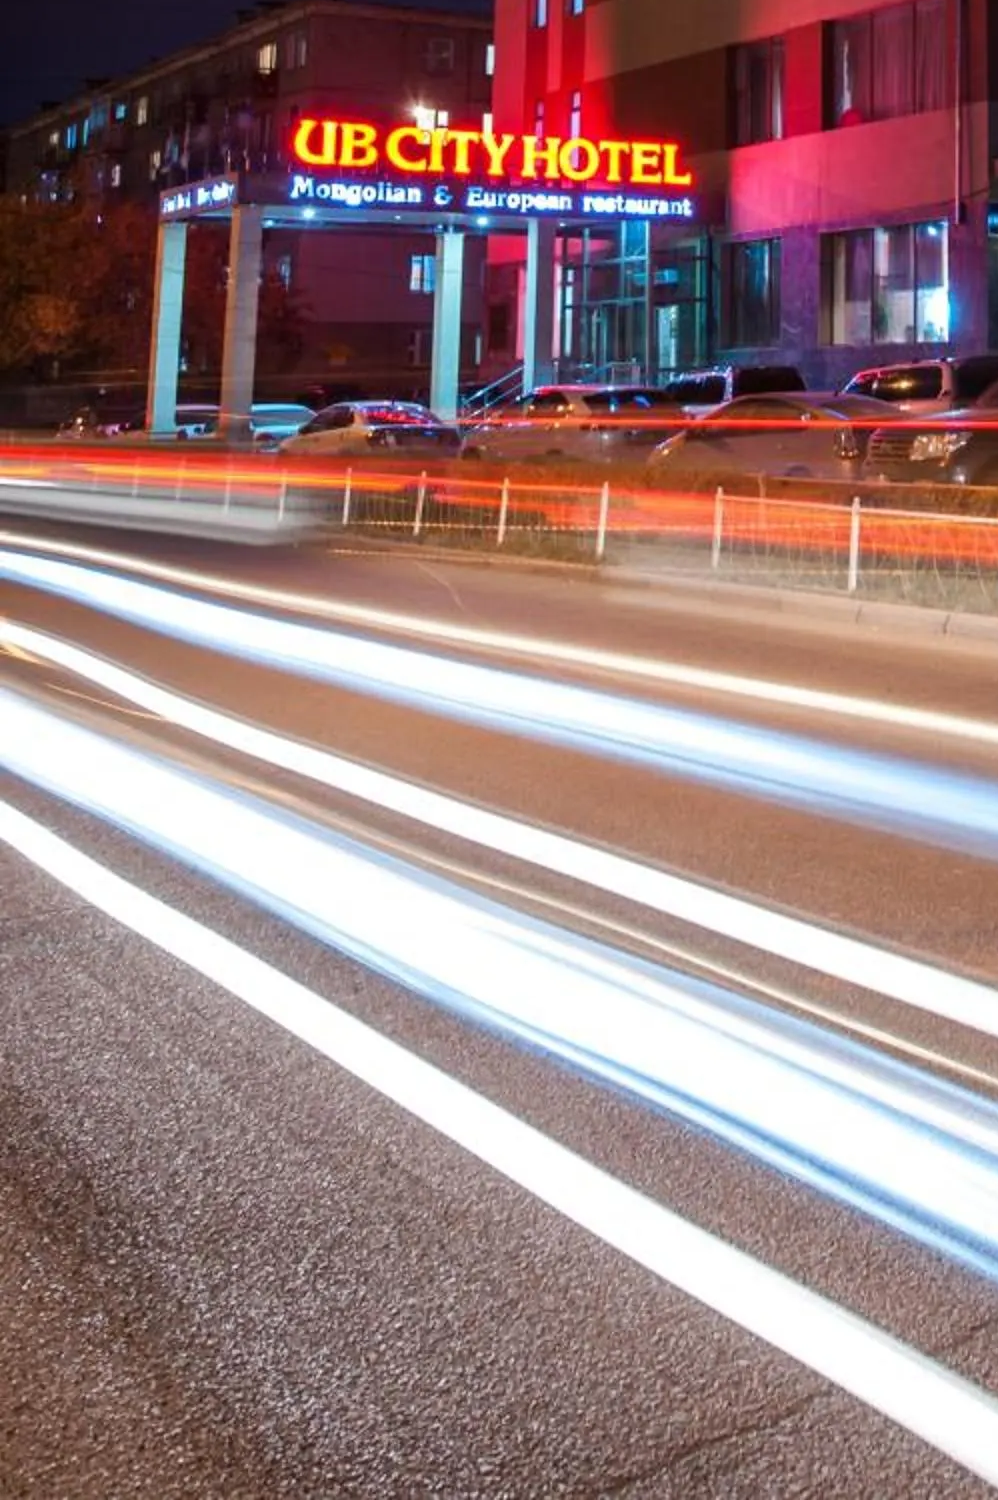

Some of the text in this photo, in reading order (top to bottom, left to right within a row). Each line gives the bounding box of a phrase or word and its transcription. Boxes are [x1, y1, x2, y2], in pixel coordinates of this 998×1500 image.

[292, 117, 693, 187] UB CITY HOTEL
[289, 175, 693, 217] Mongolian & European restaurant
